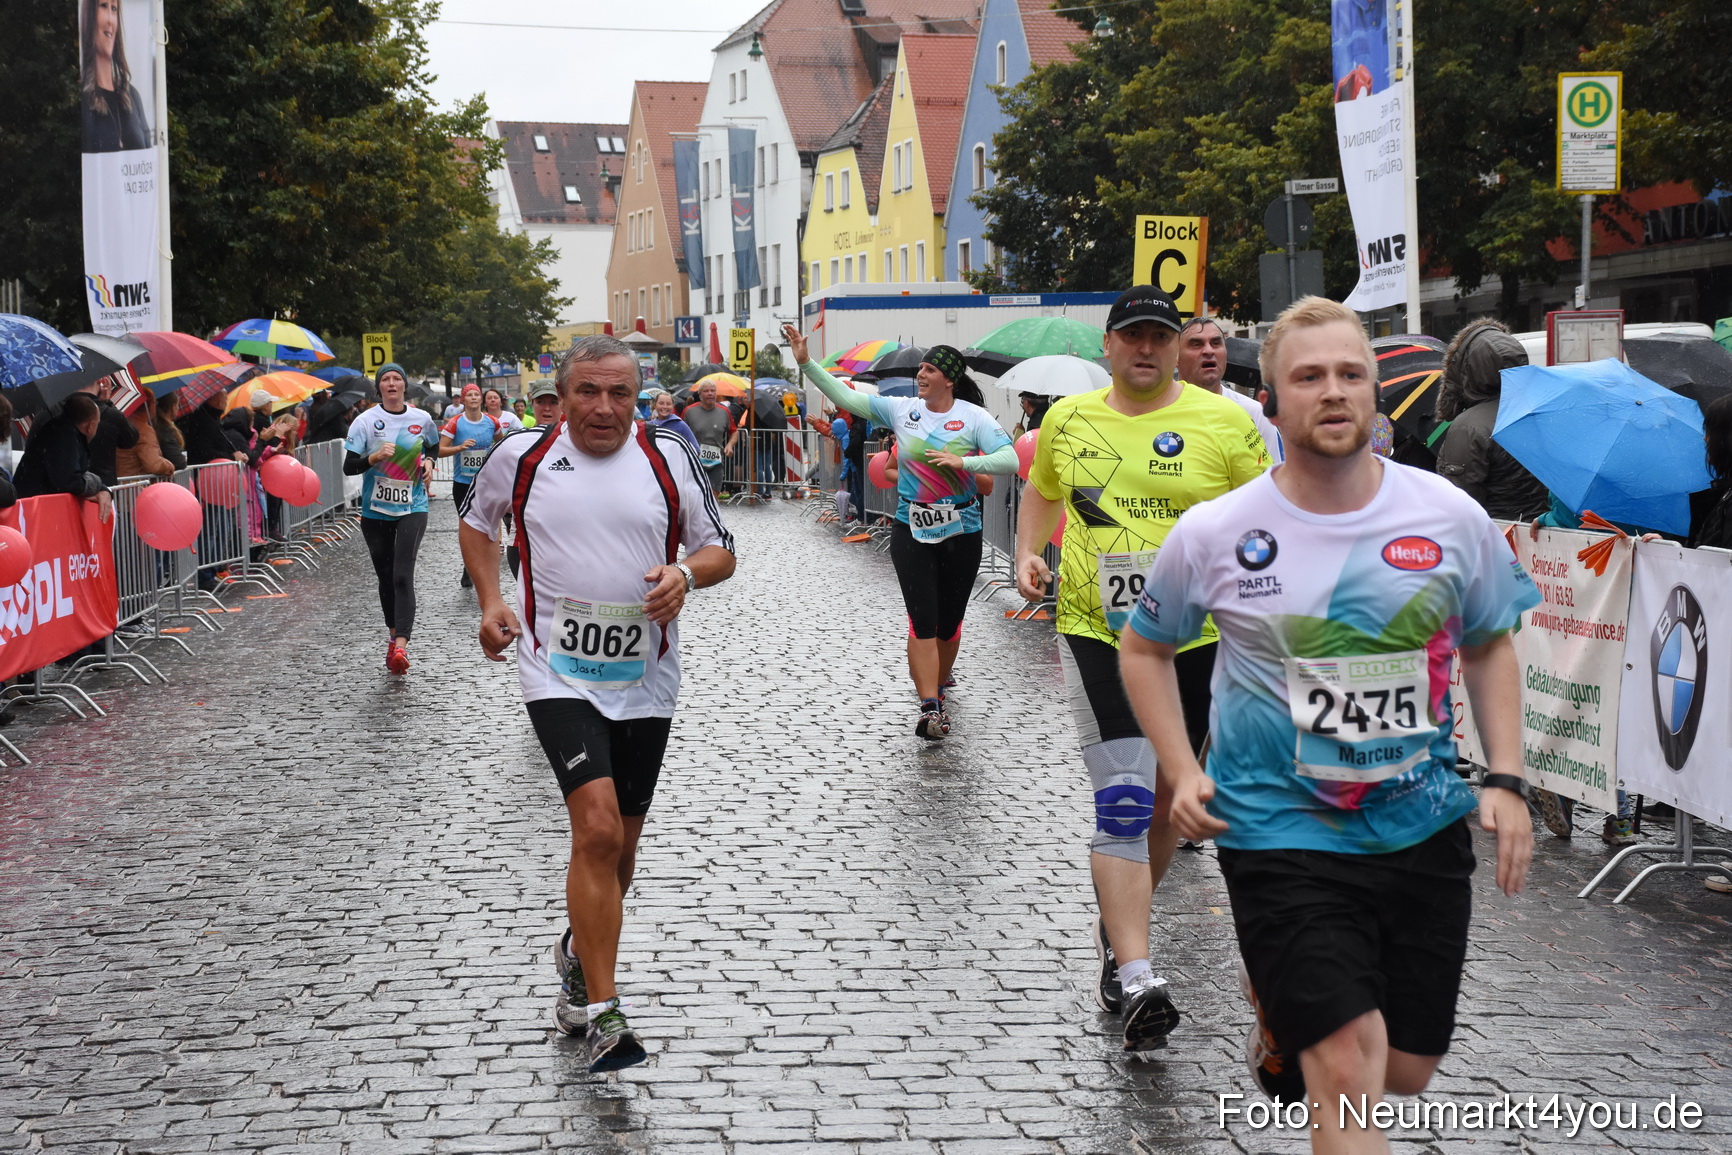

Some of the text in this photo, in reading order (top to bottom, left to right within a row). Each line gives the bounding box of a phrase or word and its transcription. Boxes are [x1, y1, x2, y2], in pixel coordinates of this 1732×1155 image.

[1570, 132, 1608, 140] Marktplatz
[1294, 181, 1335, 191] Ulmer Gasse
[1144, 220, 1199, 240] Block
[833, 231, 851, 250] HOTEL
[1151, 248, 1187, 302] C
[1153, 299, 1169, 309] DTM
[366, 335, 388, 343] Block
[732, 329, 752, 338] Block
[371, 346, 386, 367] D
[735, 340, 749, 361] D
[1149, 459, 1183, 472] Partl
[376, 485, 409, 503] 3008
[1114, 497, 1171, 508] THE NEXT
[1127, 508, 1149, 519] 100
[1390, 545, 1437, 564] Hervis
[1531, 554, 1570, 579] Service-Line:
[1238, 576, 1282, 590] PARTL
[1239, 588, 1283, 599] Neumarkt
[1543, 583, 1552, 603] 81
[1556, 585, 1565, 605] 63
[1565, 587, 1575, 607] 52
[562, 604, 593, 616] NeuerMarkt
[560, 618, 642, 658] 3062
[569, 658, 605, 677] Josef
[1349, 657, 1418, 678] BOCK
[1308, 686, 1418, 734] 2475
[1338, 745, 1404, 765] Marcus
